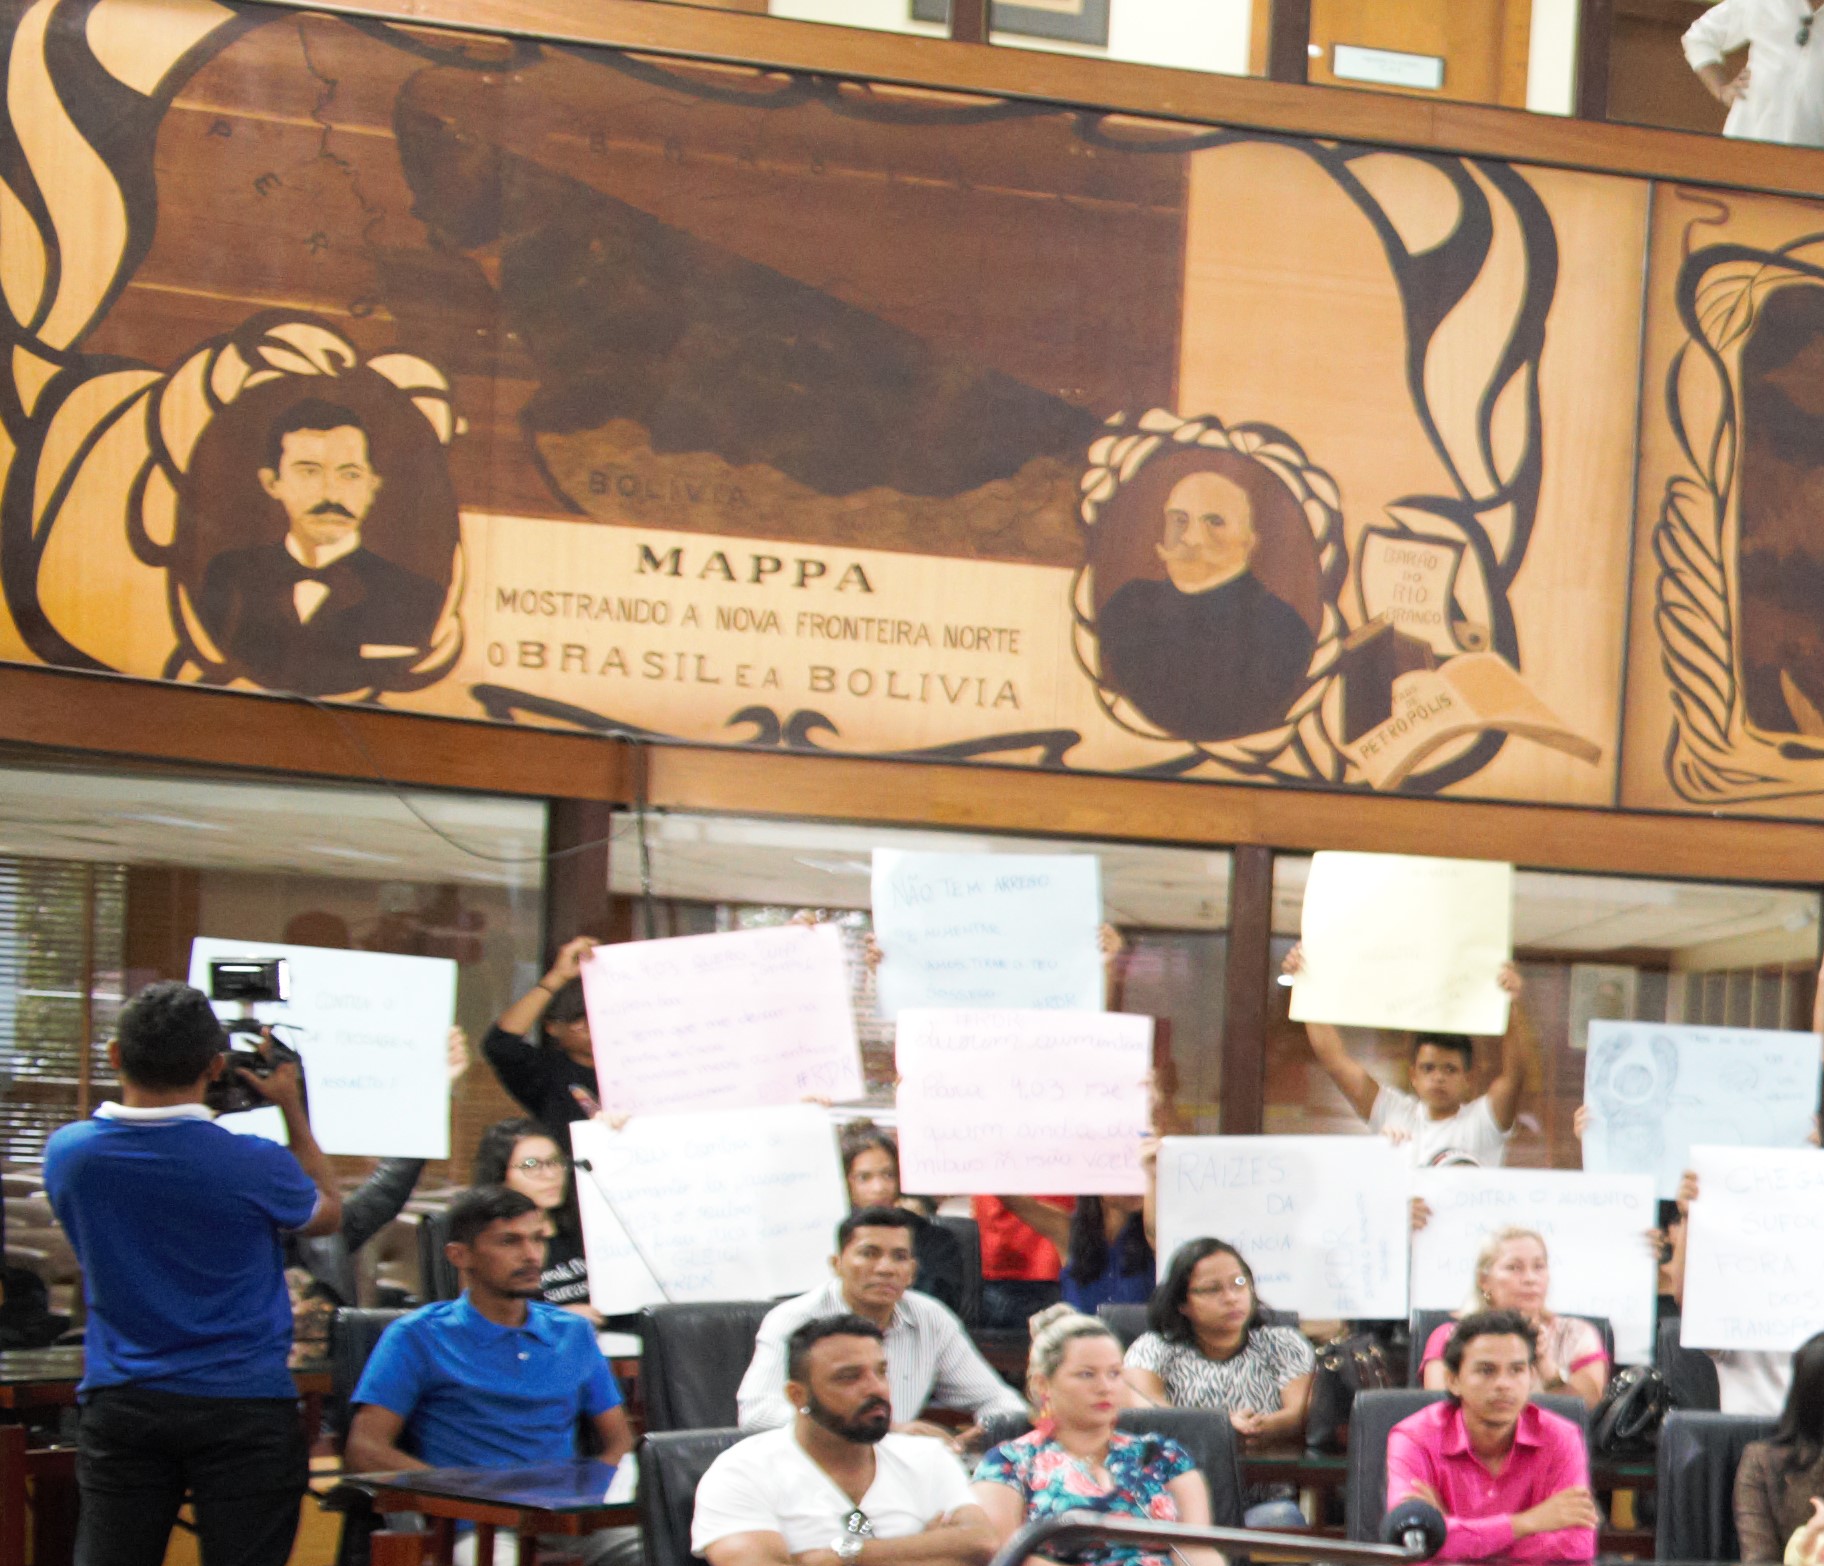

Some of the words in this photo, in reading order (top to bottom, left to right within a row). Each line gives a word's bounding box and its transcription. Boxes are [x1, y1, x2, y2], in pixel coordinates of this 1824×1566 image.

[633, 541, 876, 595] MAPPA
[1393, 583, 1430, 605] RIO
[495, 586, 673, 627] MOSTRANDO
[680, 602, 702, 628] A
[716, 604, 782, 636] NOVA
[796, 611, 933, 649] FRONTEIRA
[942, 625, 1023, 656] NORTE
[487, 641, 509, 668] O
[515, 639, 721, 686] BRASIL
[735, 664, 755, 688] E
[761, 667, 783, 690] A
[807, 665, 1023, 711] BOLIVIA
[1177, 1152, 1287, 1194] RAIZES
[1266, 1193, 1296, 1216] DA
